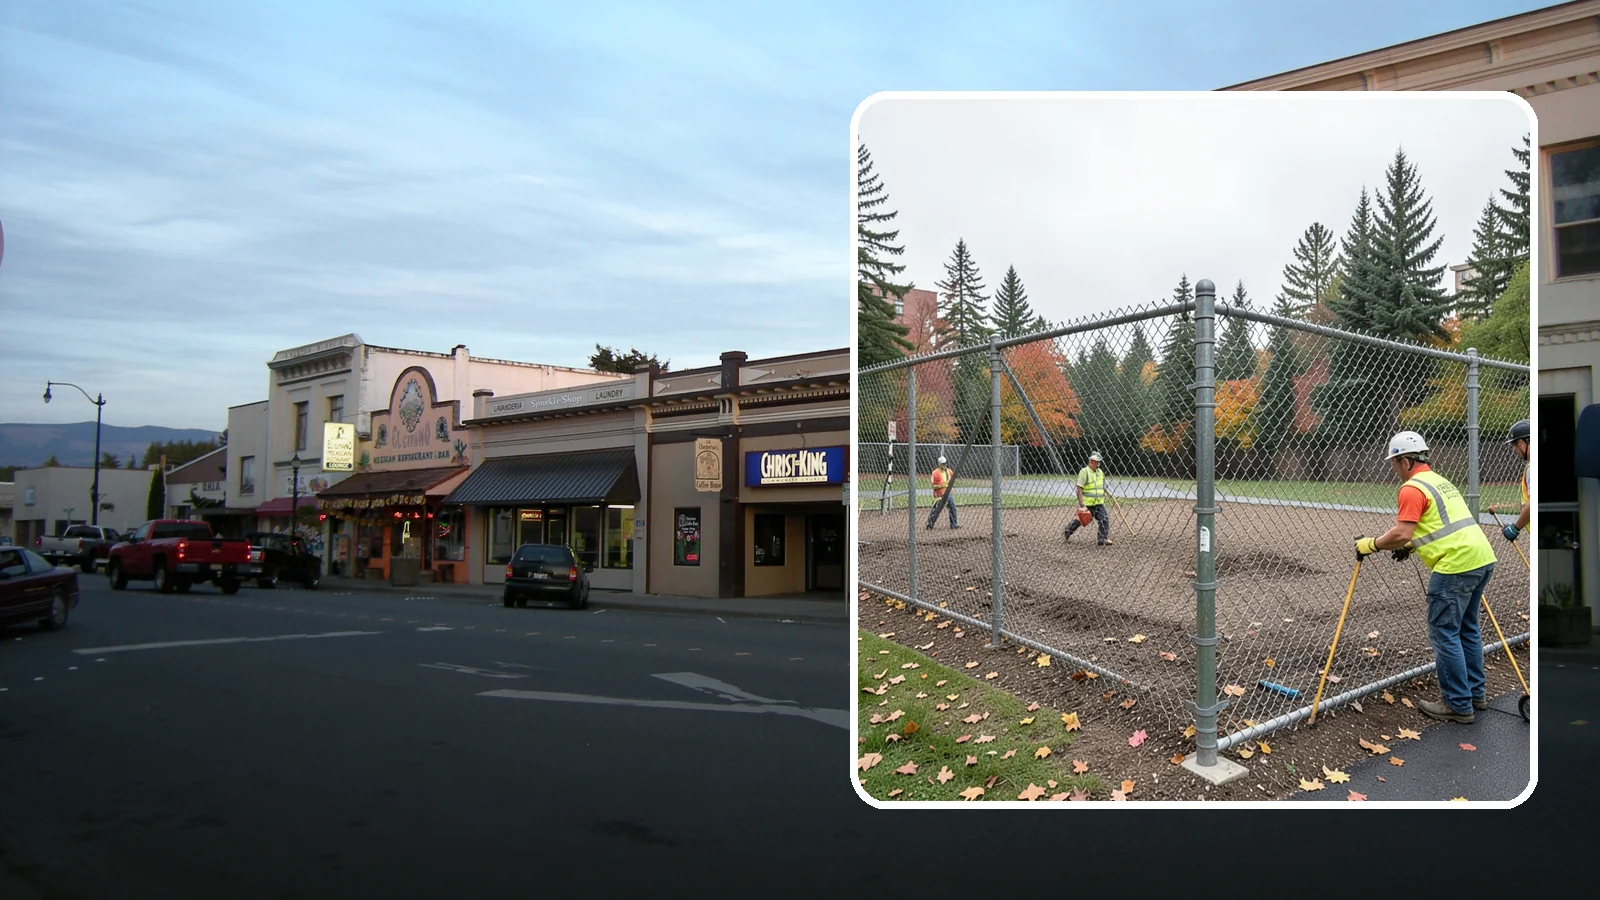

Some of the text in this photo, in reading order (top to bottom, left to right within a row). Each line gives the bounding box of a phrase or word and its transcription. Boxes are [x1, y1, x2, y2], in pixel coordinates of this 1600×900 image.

[562, 394, 582, 404] Shop
[595, 389, 624, 400] LAUNDRY
[494, 402, 522, 412] LAVANDERIA
[397, 451, 433, 462] RESTAURANT
[438, 450, 450, 459] BAR
[761, 452, 797, 478] CHRIST
[800, 450, 827, 476] KING
